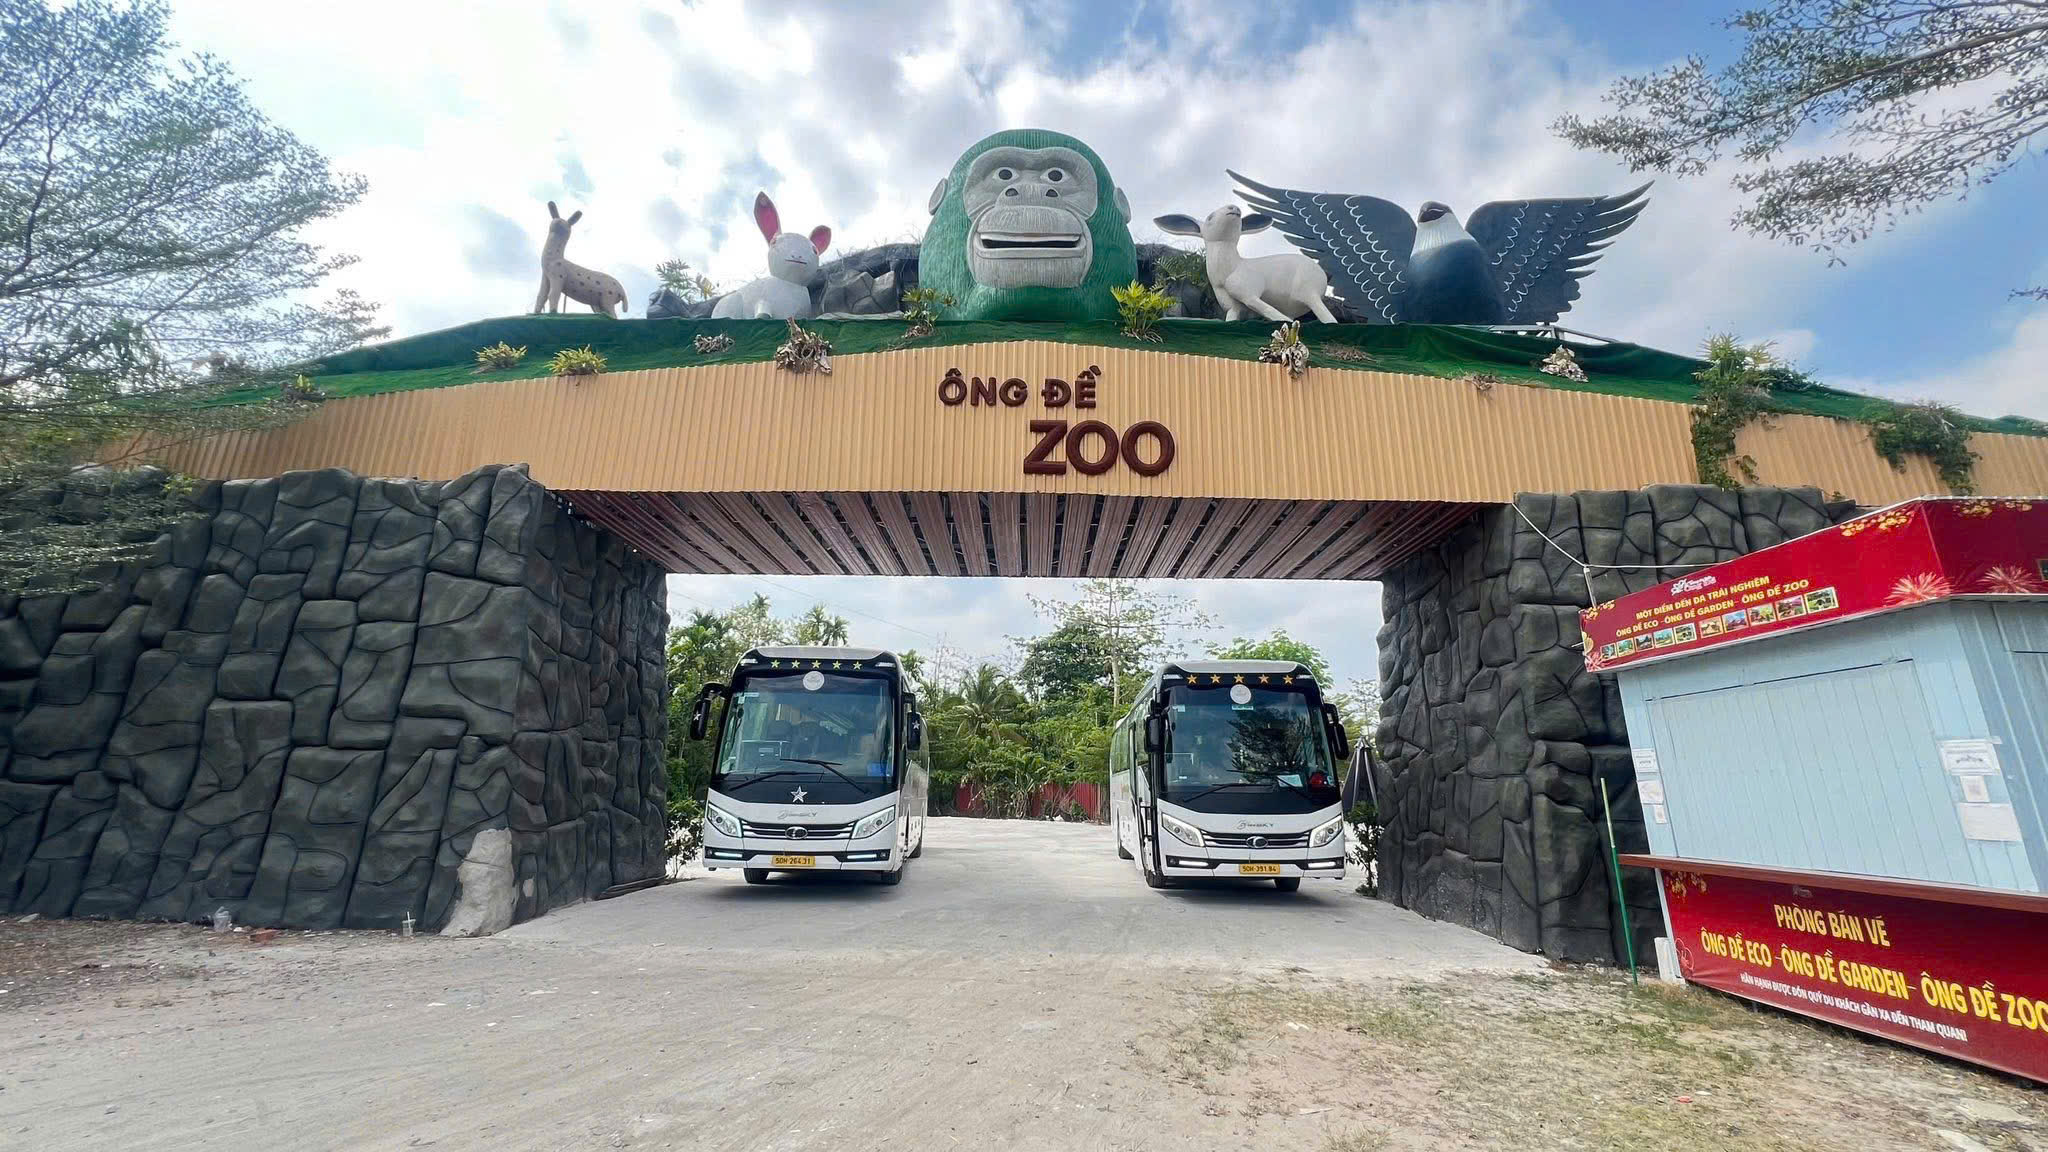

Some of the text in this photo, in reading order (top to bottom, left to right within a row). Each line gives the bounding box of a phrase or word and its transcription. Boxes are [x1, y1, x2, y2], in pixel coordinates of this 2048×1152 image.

[938, 365, 1102, 409] ÔNG ĐỀ
[1023, 419, 1176, 477] ZOO
[1615, 626, 1632, 637] ÔNG
[1643, 619, 1659, 629] ECO
[1741, 590, 1765, 604] ÔNG
[1782, 579, 1810, 593] ZOO
[1774, 902, 1892, 947] PHÒNG BÁN VÉ
[1700, 926, 1728, 957] ÔNG
[1727, 931, 1746, 961] ĐỀ
[1745, 940, 1773, 968] ECO
[1814, 948, 1839, 984] ĐỀ
[1920, 971, 1969, 1014] ÔNG
[1968, 980, 2002, 1022] ĐỀ
[1753, 976, 1773, 991] HẠNH
[1834, 997, 1862, 1014] KHÁCH
[1877, 1007, 1893, 1022] XA
[1907, 1015, 1937, 1034] THAM
